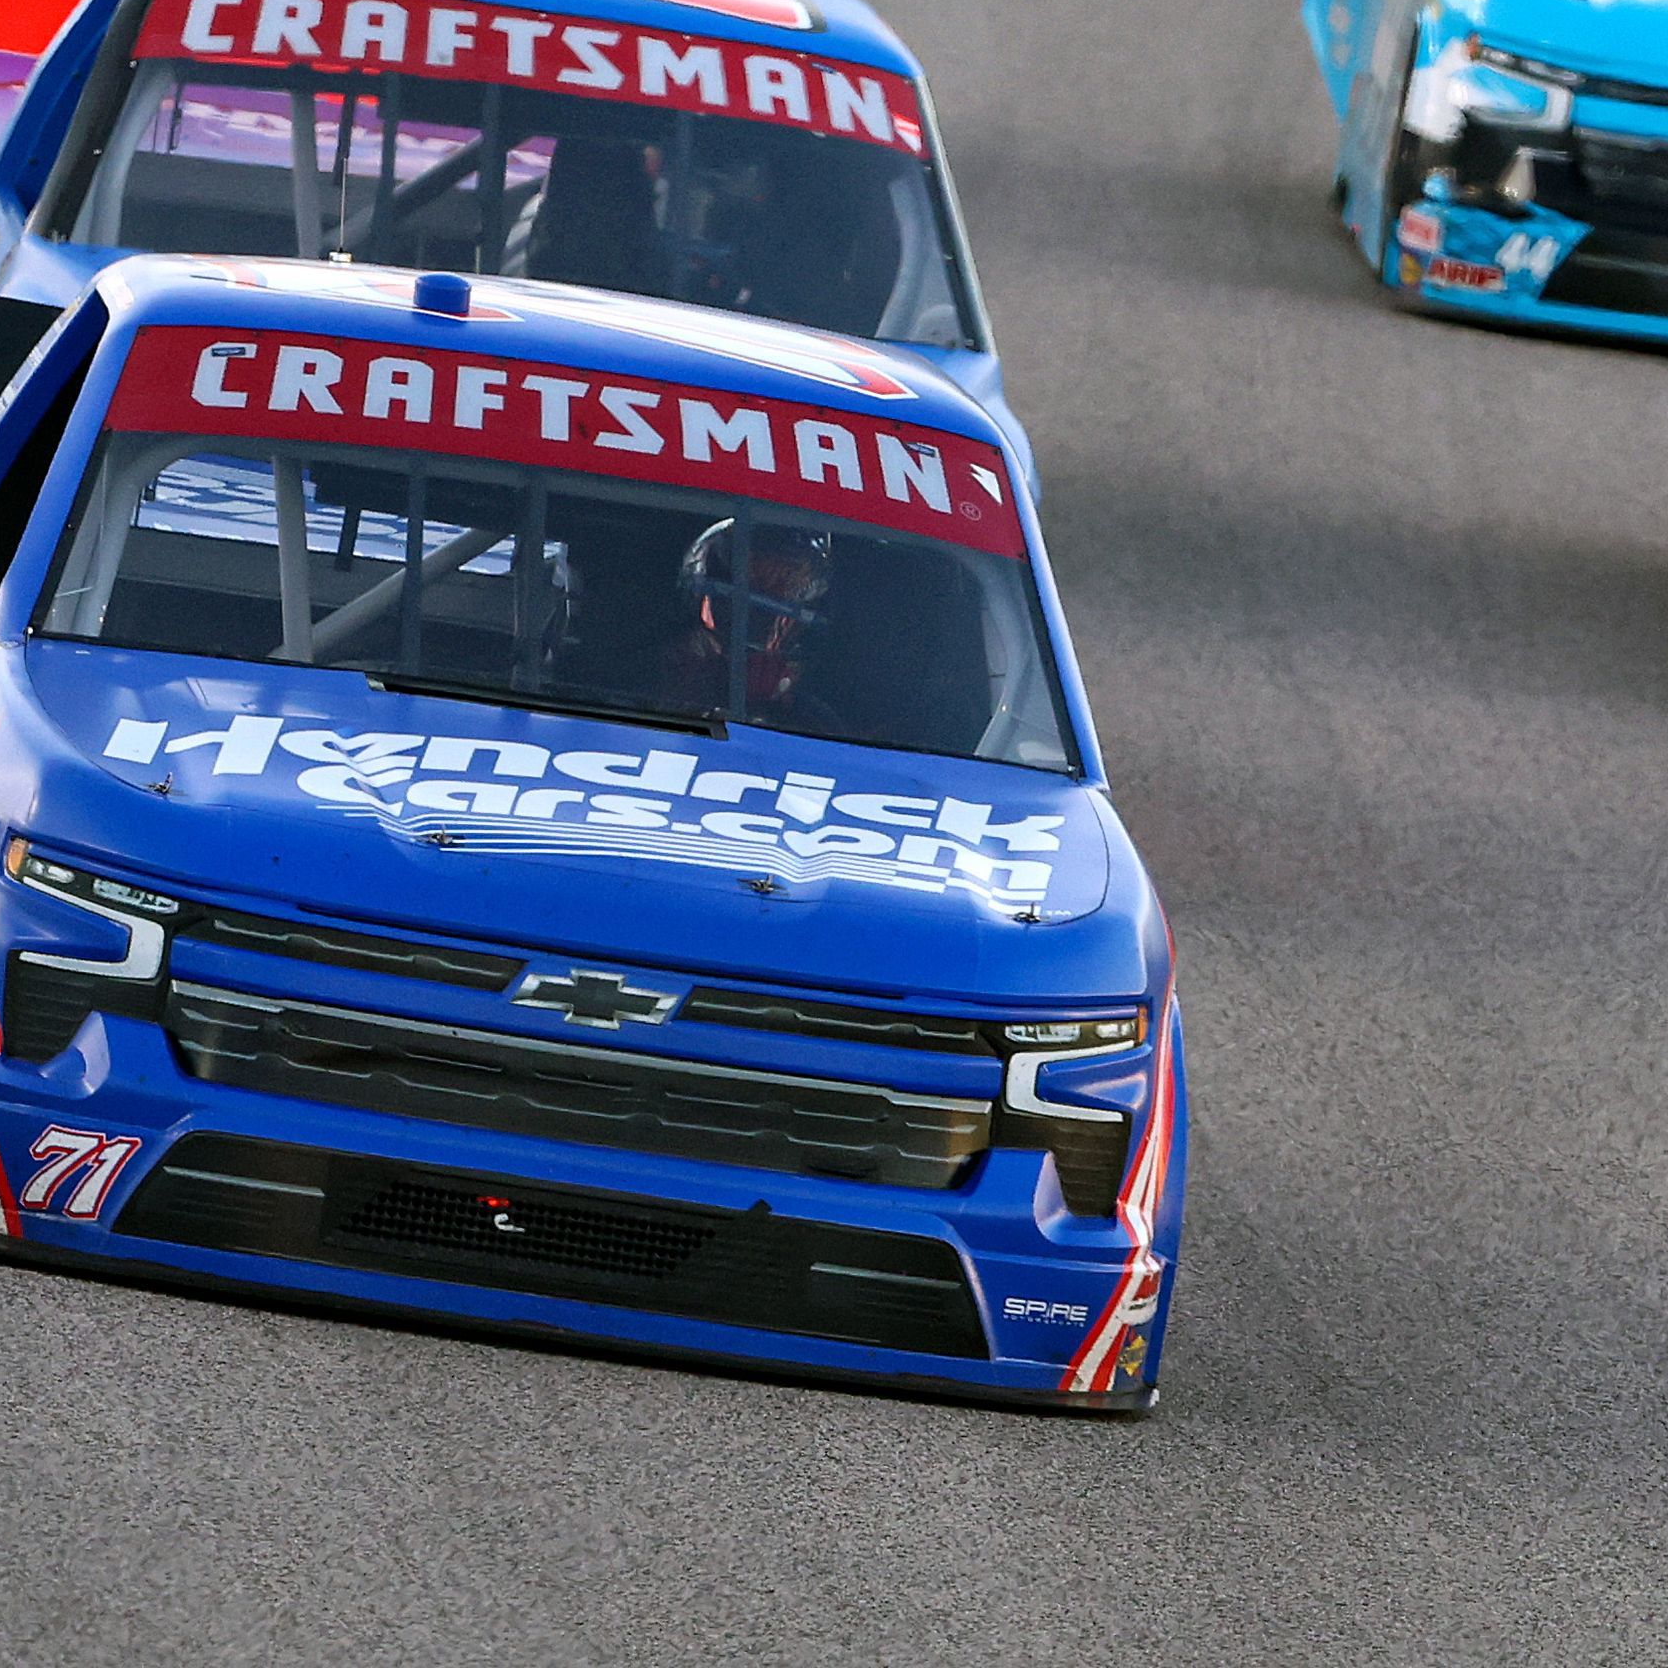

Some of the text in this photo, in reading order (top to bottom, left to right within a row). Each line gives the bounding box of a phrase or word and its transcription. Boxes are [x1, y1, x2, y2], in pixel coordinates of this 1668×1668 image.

[190, 340, 953, 515] CRAFTSMAN
[101, 713, 1066, 853] Hendrick
[20, 1123, 144, 1221] 71
[1003, 1297, 1089, 1322] SPIRE
